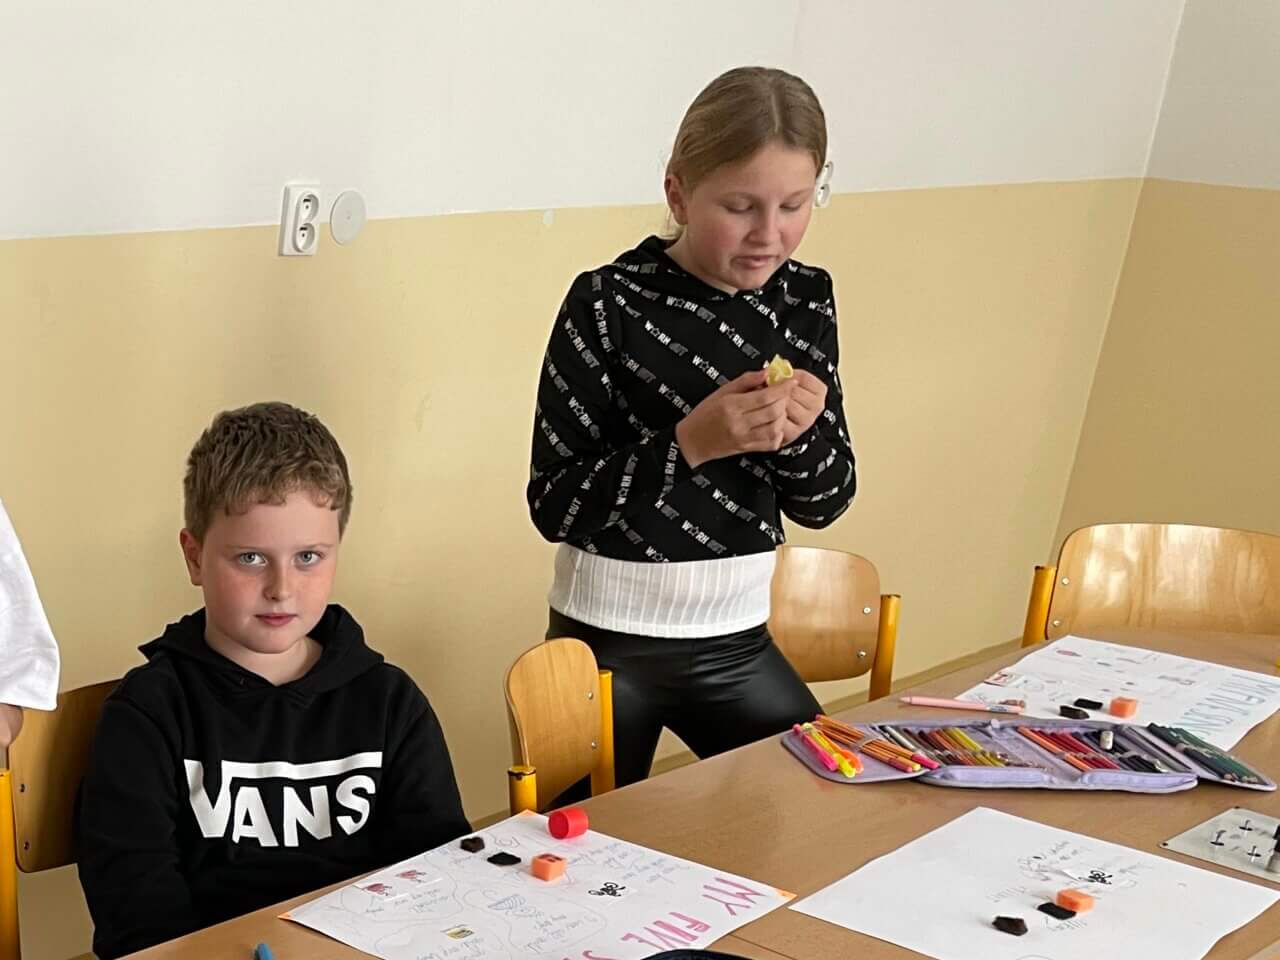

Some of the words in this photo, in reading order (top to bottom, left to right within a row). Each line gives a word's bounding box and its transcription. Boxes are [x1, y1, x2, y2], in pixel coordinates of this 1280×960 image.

[184, 752, 382, 847] VANS
[702, 876, 767, 917] MY
[621, 911, 711, 952] FIVE
